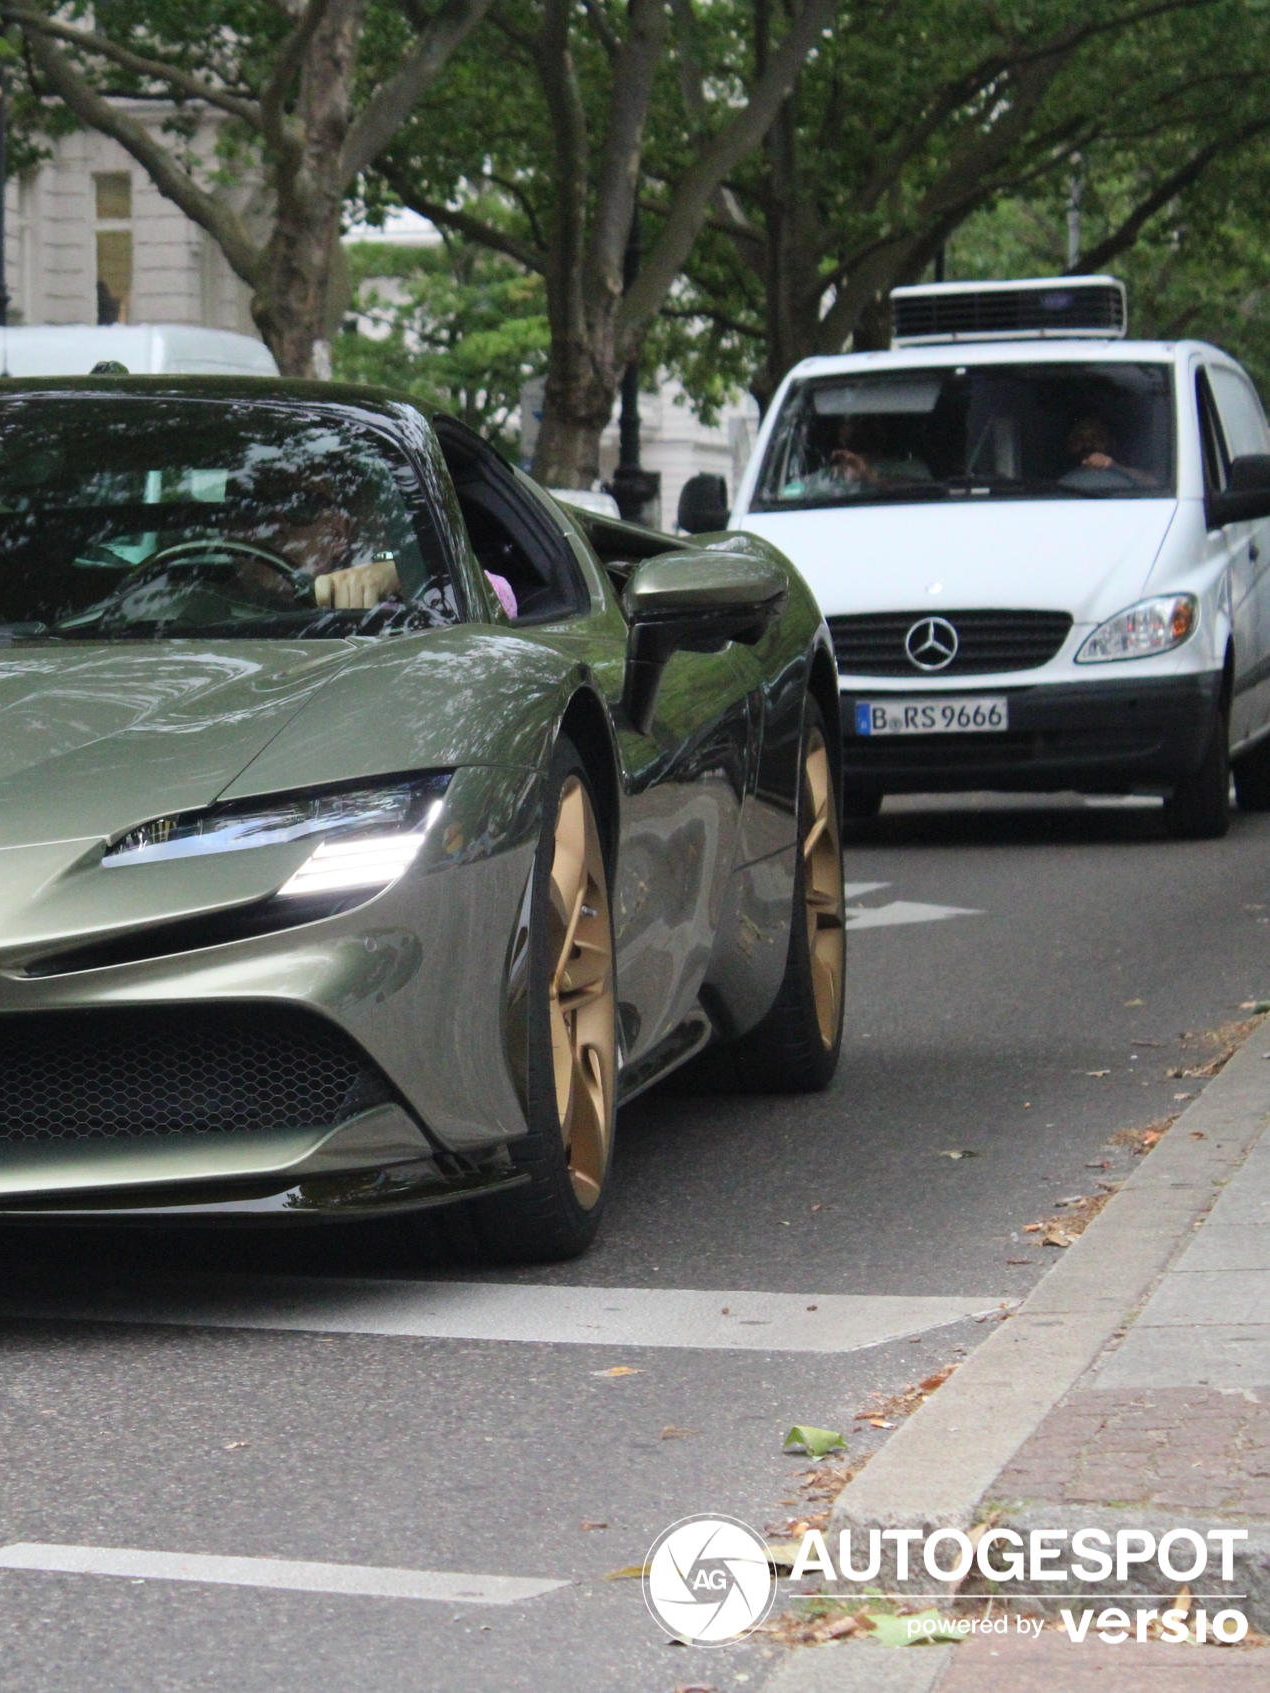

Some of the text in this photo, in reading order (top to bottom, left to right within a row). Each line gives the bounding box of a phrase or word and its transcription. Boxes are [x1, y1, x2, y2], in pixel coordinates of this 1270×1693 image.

[872, 706, 887, 730] B
[904, 705, 936, 729] RS
[941, 703, 1003, 728] 9666
